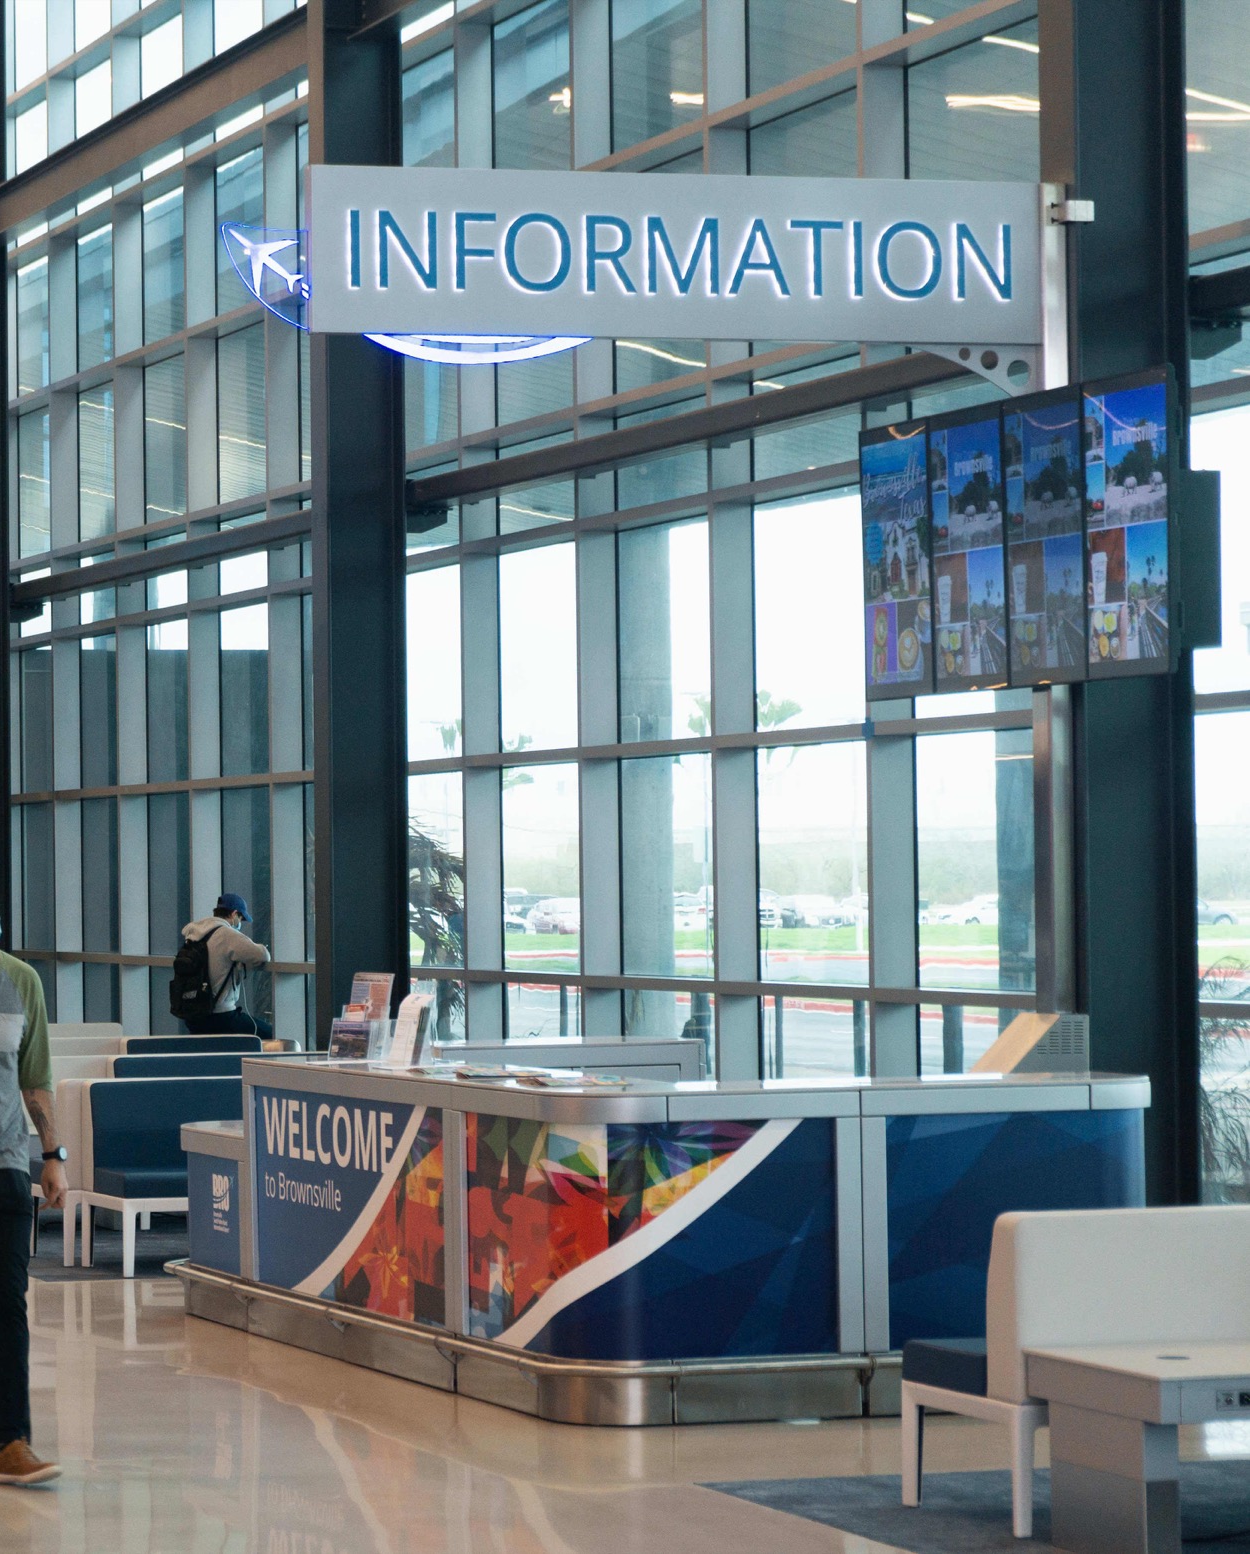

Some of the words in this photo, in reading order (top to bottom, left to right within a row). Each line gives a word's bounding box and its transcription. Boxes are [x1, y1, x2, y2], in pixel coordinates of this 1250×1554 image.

[348, 209, 1012, 301] INFORMATION
[263, 1096, 393, 1174] WELCOME
[265, 1171, 276, 1198] to
[278, 1171, 341, 1212] Brownsville
